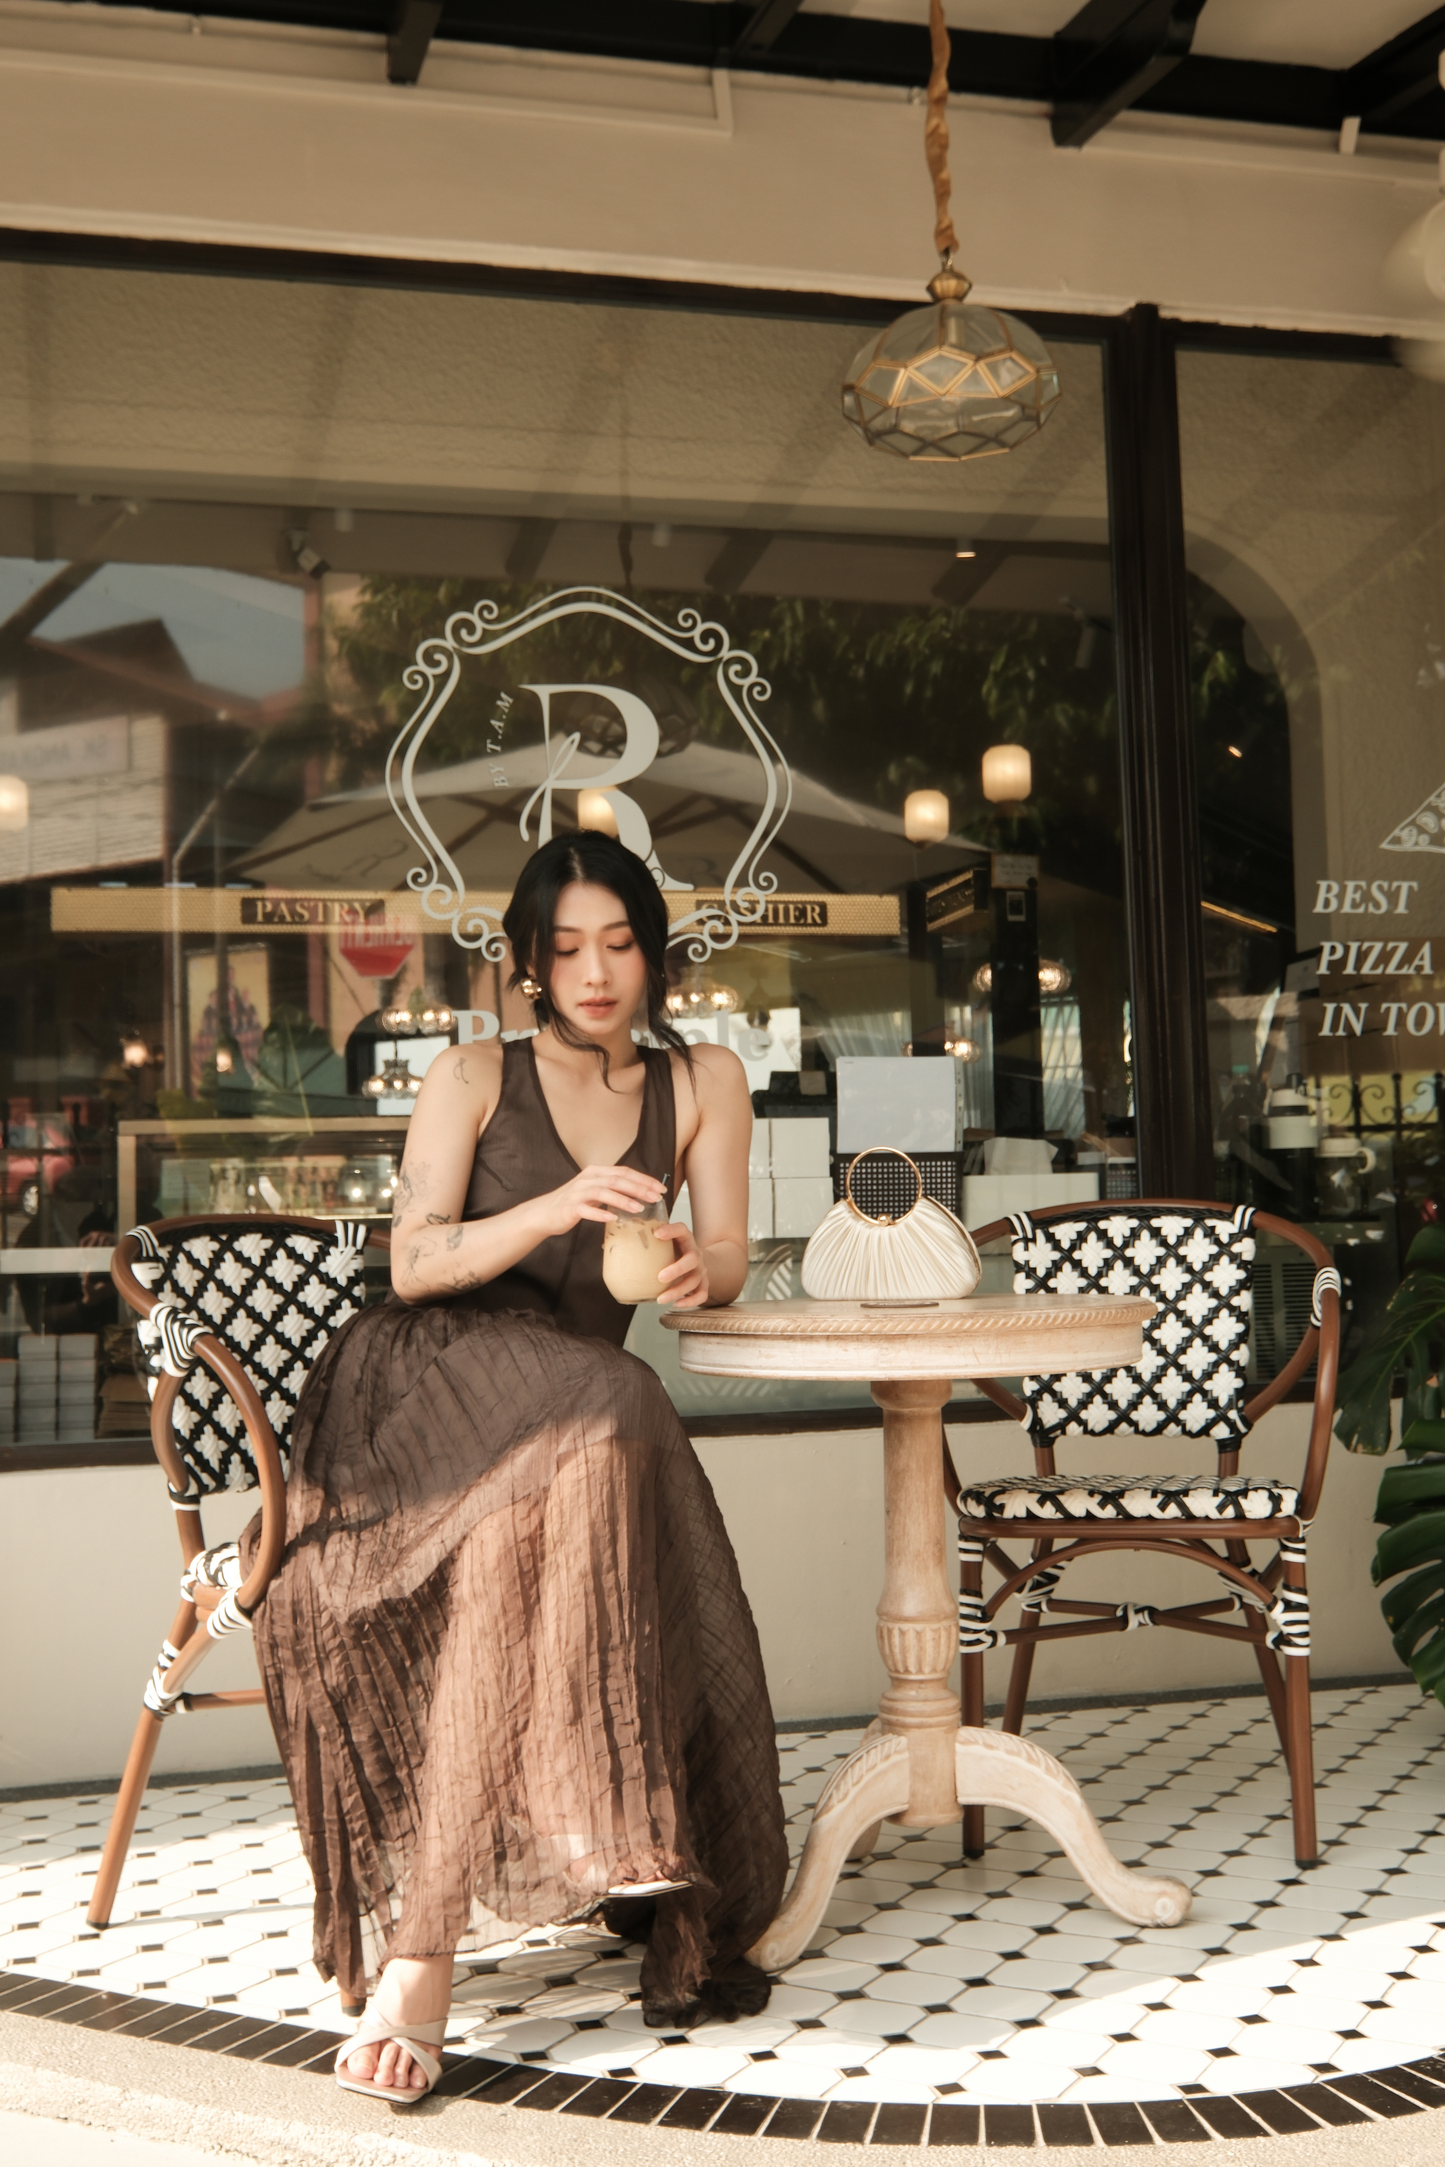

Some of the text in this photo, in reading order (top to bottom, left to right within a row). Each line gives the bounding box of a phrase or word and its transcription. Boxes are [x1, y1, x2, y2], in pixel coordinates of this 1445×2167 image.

[488, 762, 509, 787] BY
[255, 900, 372, 923] PASTRY
[1312, 880, 1419, 915] BEST
[1315, 941, 1434, 975] PIZZA
[1318, 1001, 1445, 1037] IN TO
